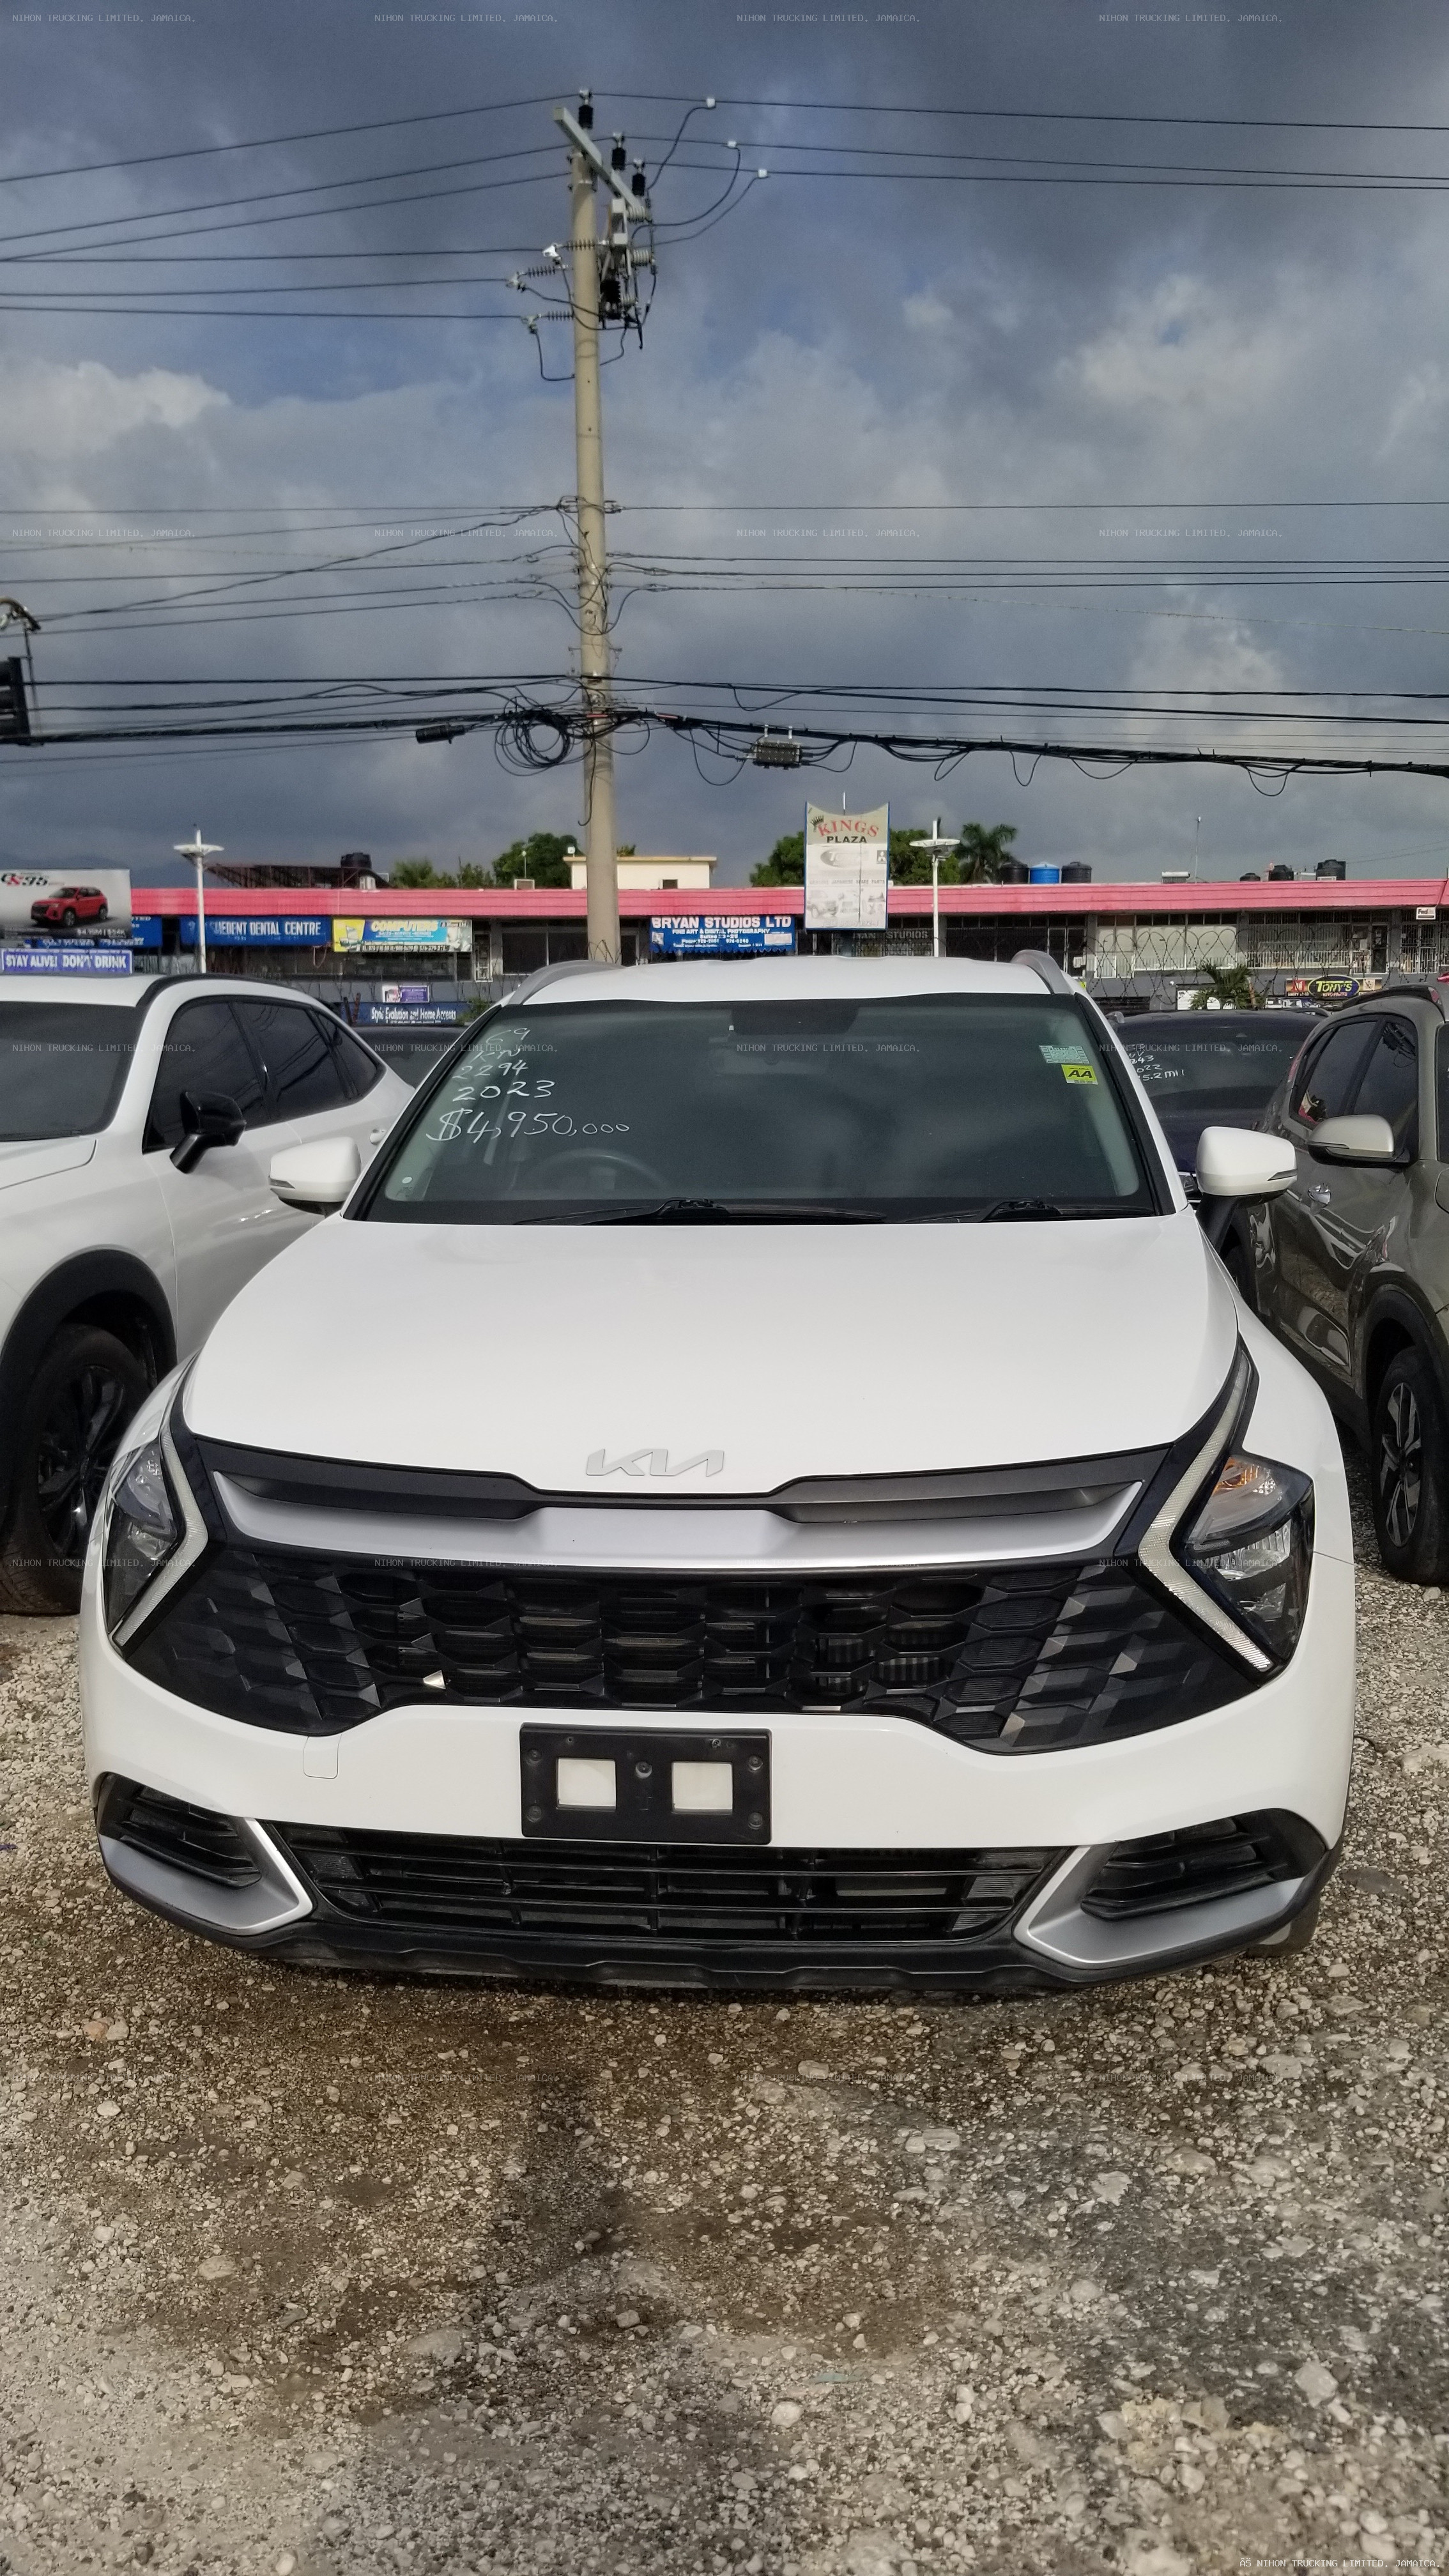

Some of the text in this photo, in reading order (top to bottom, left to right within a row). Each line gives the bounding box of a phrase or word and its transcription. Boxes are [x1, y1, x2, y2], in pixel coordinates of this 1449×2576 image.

[817, 819, 879, 837] KINGS
[250, 921, 281, 935] DENTAL
[284, 921, 321, 935] CENTRE
[371, 920, 438, 932] COMPUTERS
[652, 916, 792, 928] BRYAN STUDIOS LTD
[6, 955, 28, 967] STAY
[95, 956, 126, 968] DRINK
[1316, 981, 1353, 992] TONY'S
[420, 1008, 435, 1020] Home
[1068, 1070, 1093, 1078] AA
[1137, 1064, 1163, 1073] 022
[452, 1080, 555, 1101] 2023
[426, 1108, 630, 1143] $4,950,000
